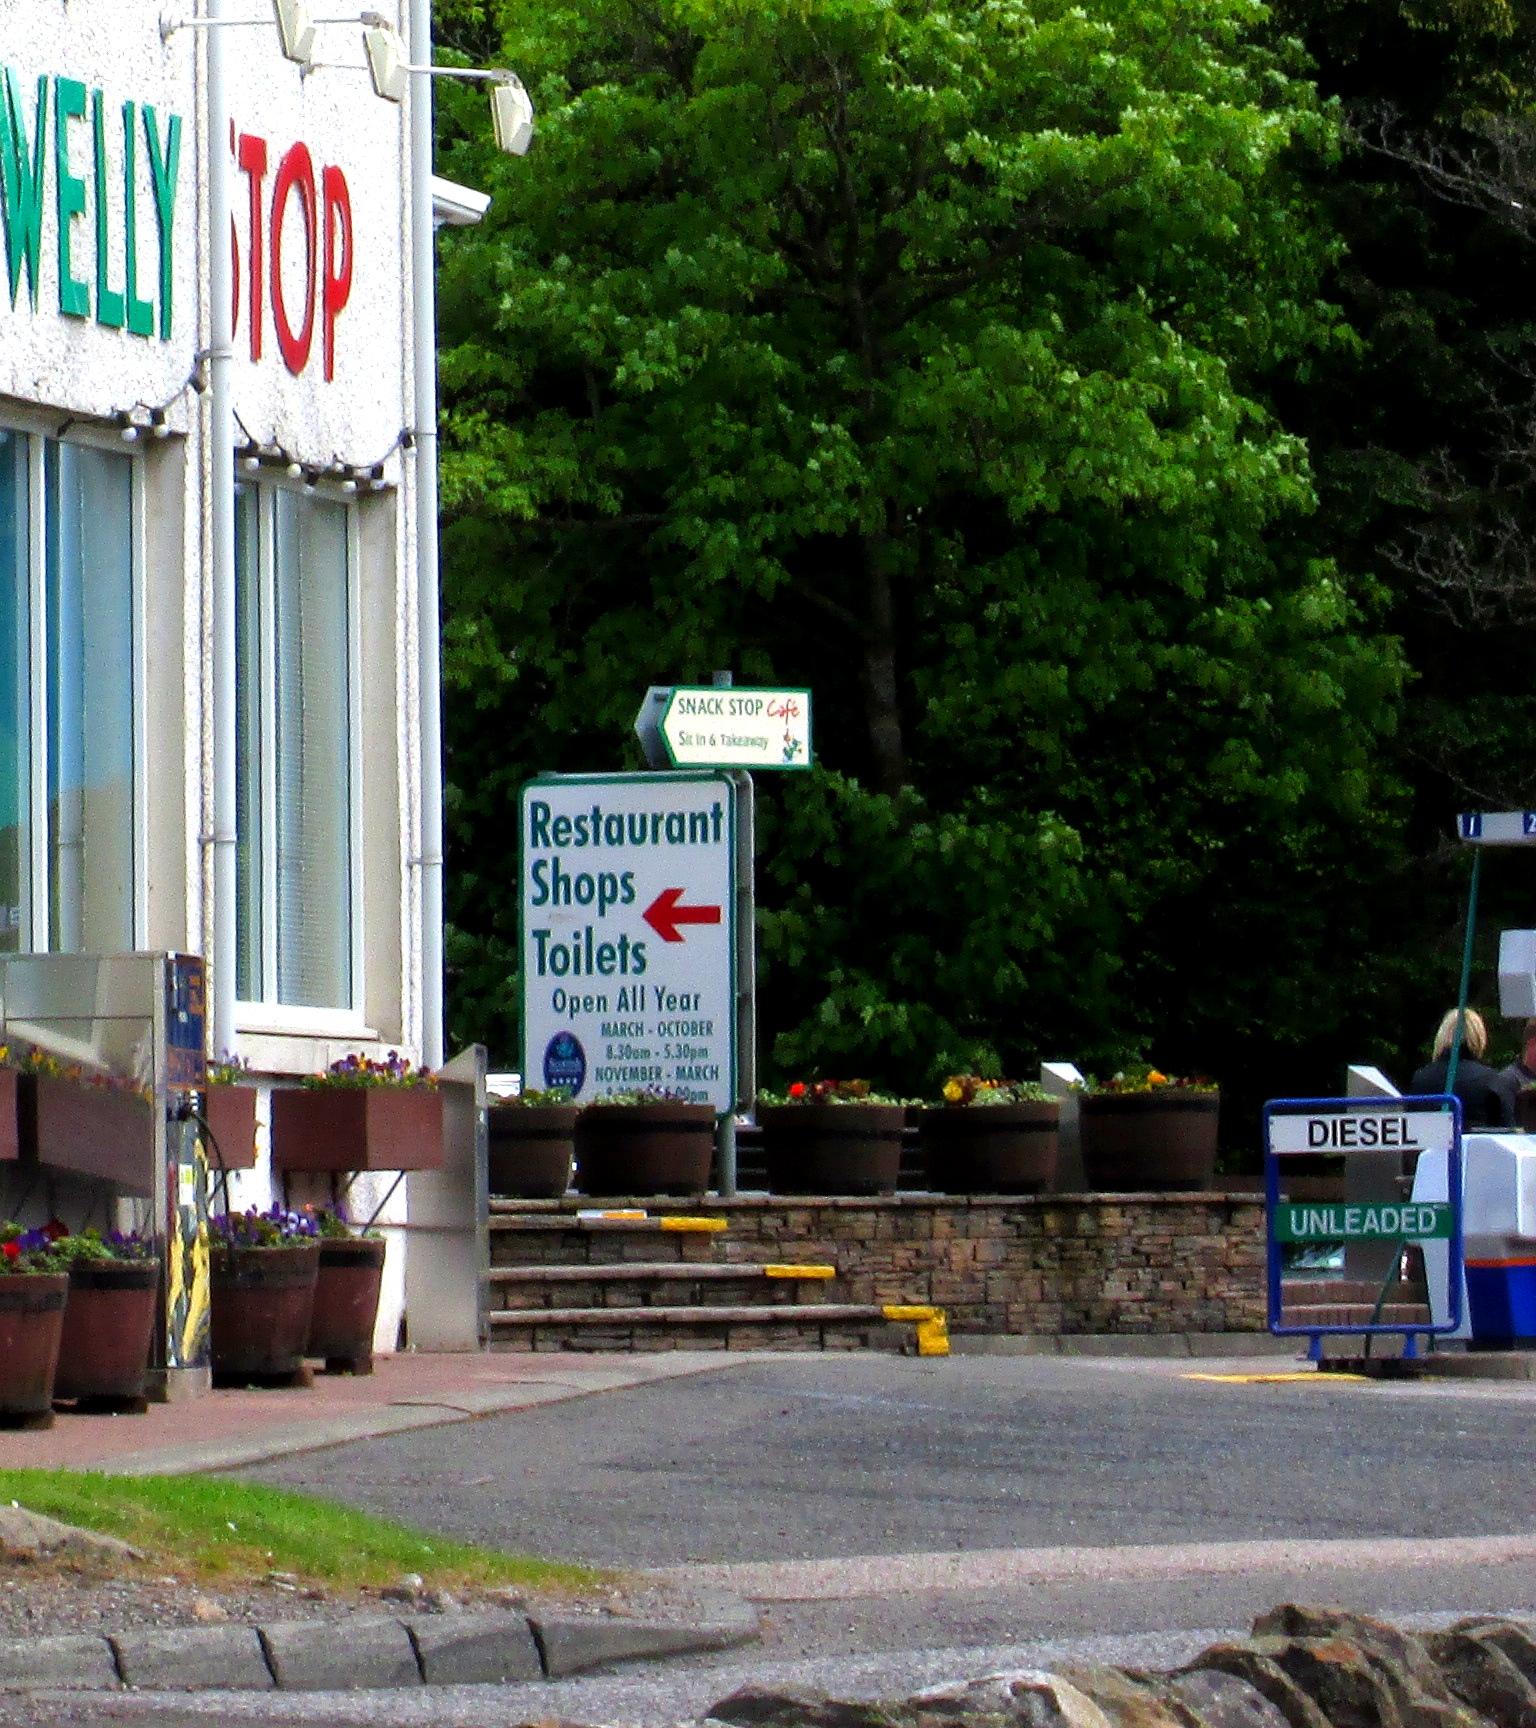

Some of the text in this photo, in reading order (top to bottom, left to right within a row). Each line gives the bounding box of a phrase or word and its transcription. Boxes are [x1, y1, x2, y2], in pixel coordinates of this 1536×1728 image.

[230, 117, 353, 383] TOP
[677, 697, 725, 716] SNACK
[728, 698, 764, 716] STOP
[678, 731, 693, 746] Sit
[530, 801, 724, 848] Restaurant
[531, 857, 637, 917] Shops
[532, 926, 647, 976] Toilets
[552, 985, 701, 1019] Open All Year
[601, 1022, 644, 1037] MARCH
[657, 1021, 714, 1037] OCTOBER
[606, 1045, 651, 1060] 8.30am
[664, 1044, 709, 1063] 5.30pm
[595, 1066, 662, 1082] NOVEMBER
[676, 1065, 720, 1081] MARCH
[1308, 1118, 1418, 1147] DIESEL
[1290, 1207, 1437, 1236] UNLEADED
